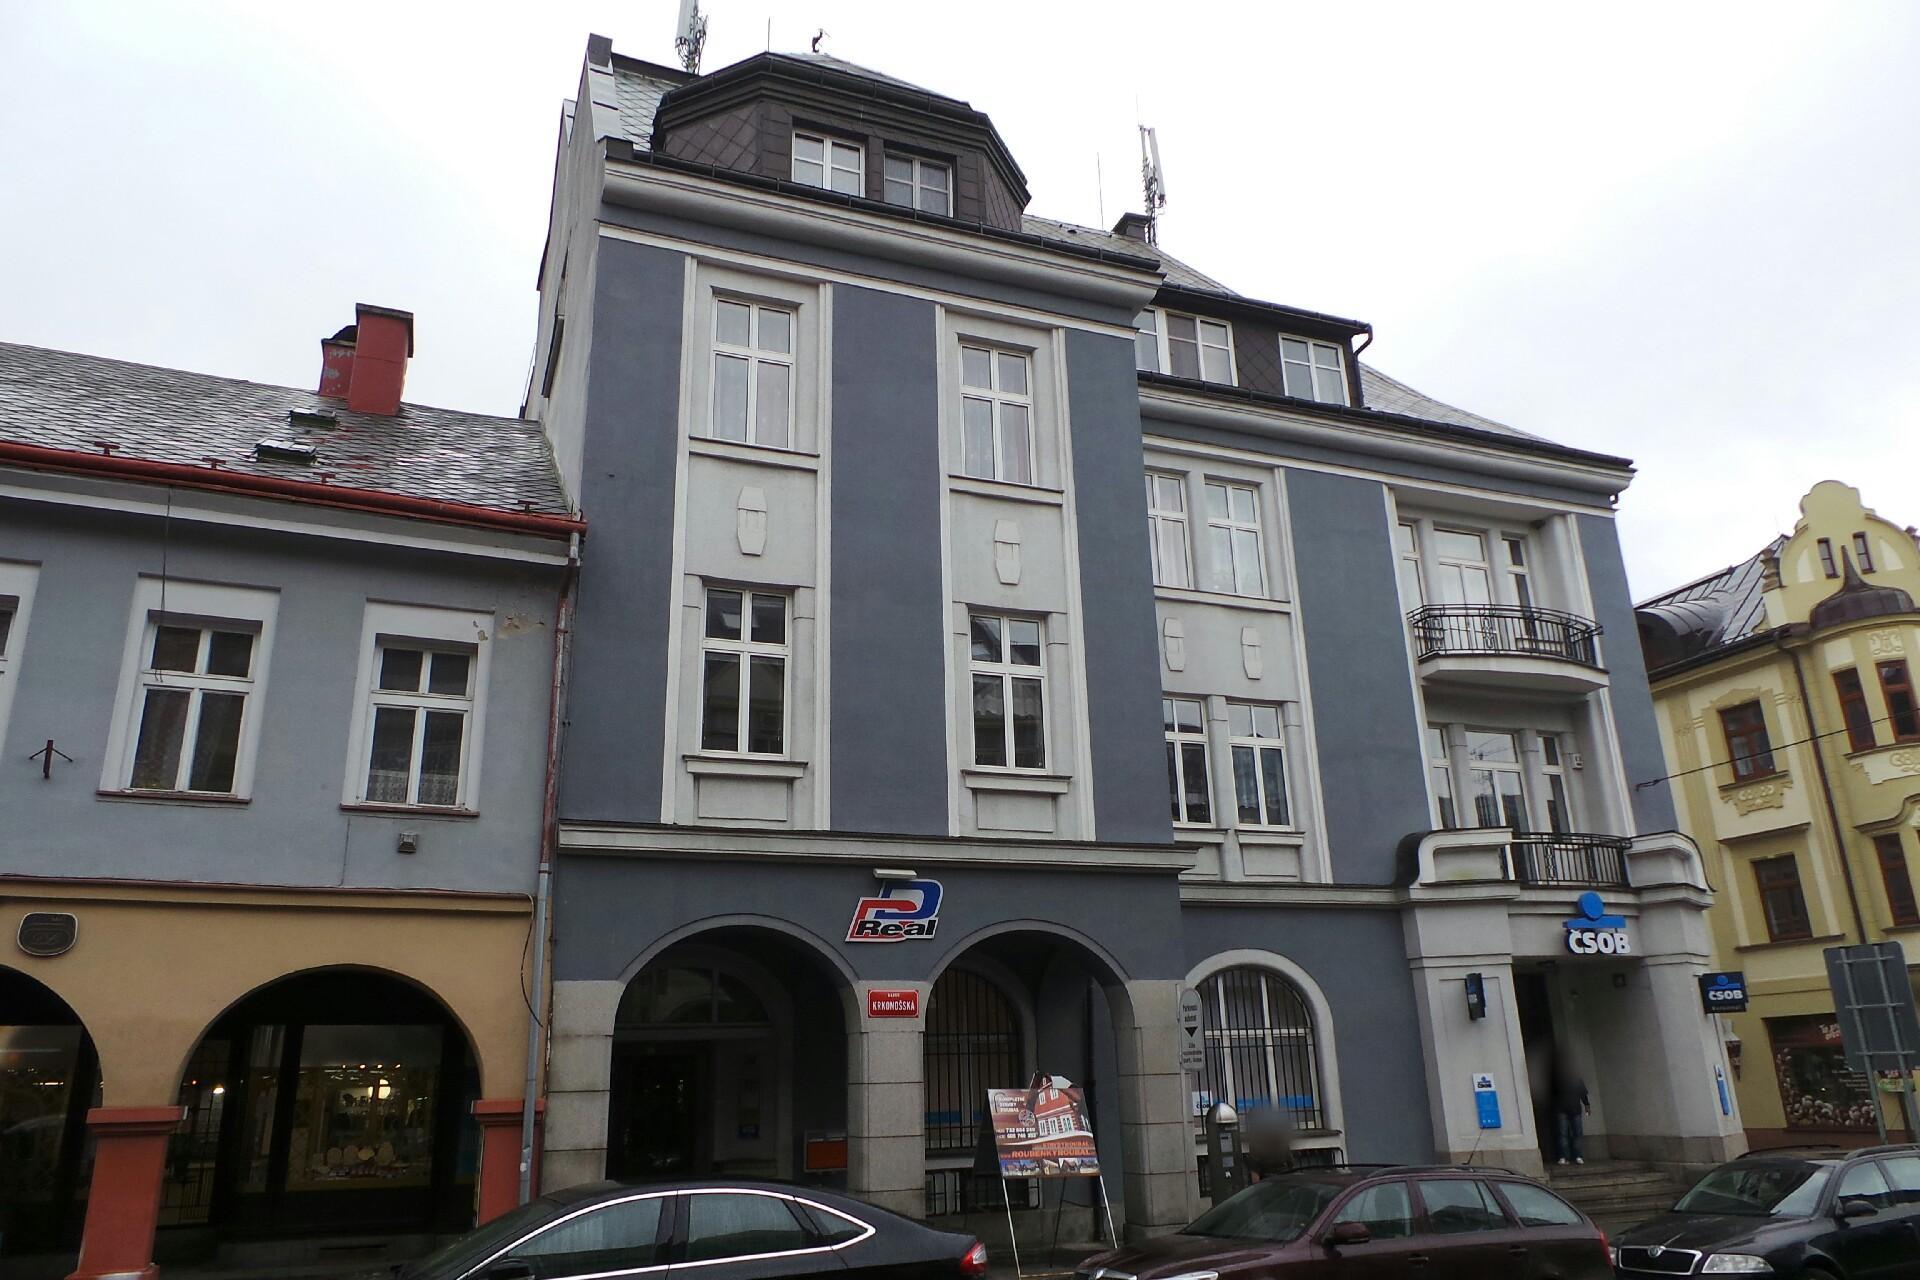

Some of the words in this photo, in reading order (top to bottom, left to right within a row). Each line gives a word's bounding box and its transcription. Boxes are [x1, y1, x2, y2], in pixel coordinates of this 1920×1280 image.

[855, 920, 937, 936] Real
[1568, 929, 1631, 954] ČSOB
[1708, 990, 1743, 1001] ČSOB
[872, 1000, 915, 1011] KRKONOŠSKÁ
